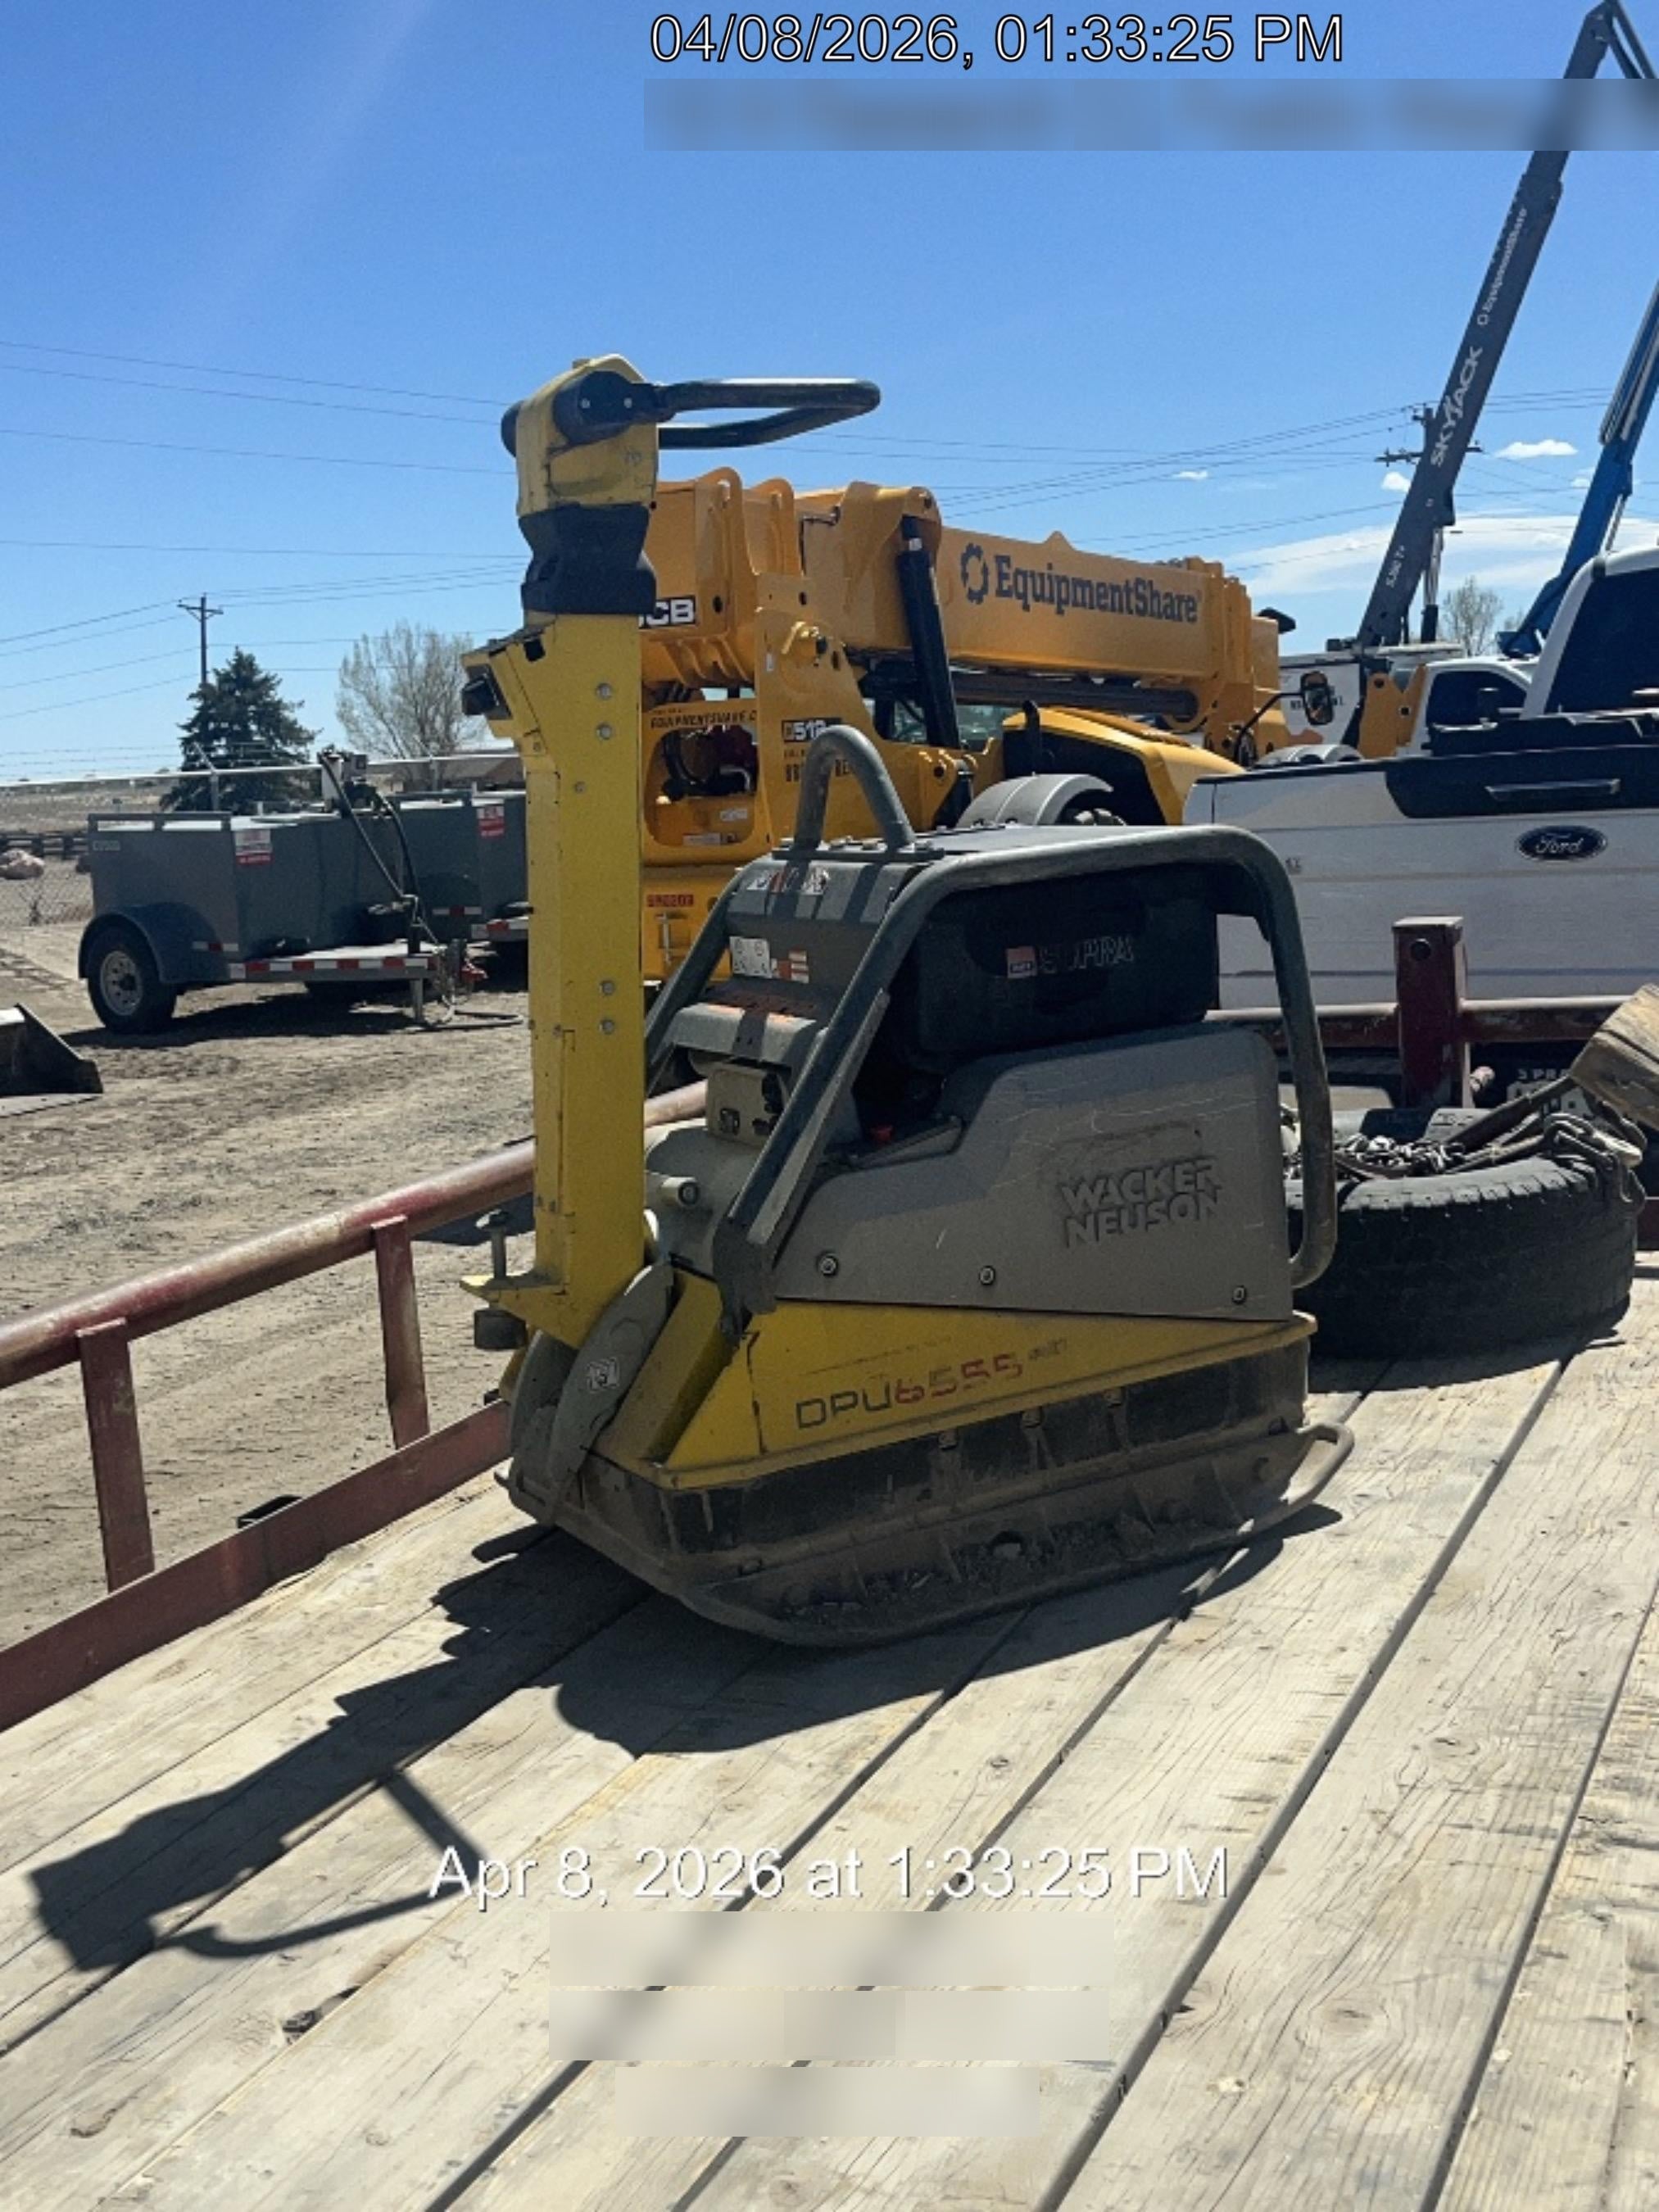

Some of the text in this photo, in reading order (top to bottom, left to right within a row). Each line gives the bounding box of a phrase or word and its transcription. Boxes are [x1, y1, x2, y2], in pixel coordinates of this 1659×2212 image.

[1430, 345, 1484, 468] SKYJACK
[995, 554, 1199, 623] EquipmentShare
[1535, 832, 1584, 854] Ford
[1061, 1156, 1222, 1212] WACKER
[1066, 1190, 1219, 1248] NEUSON
